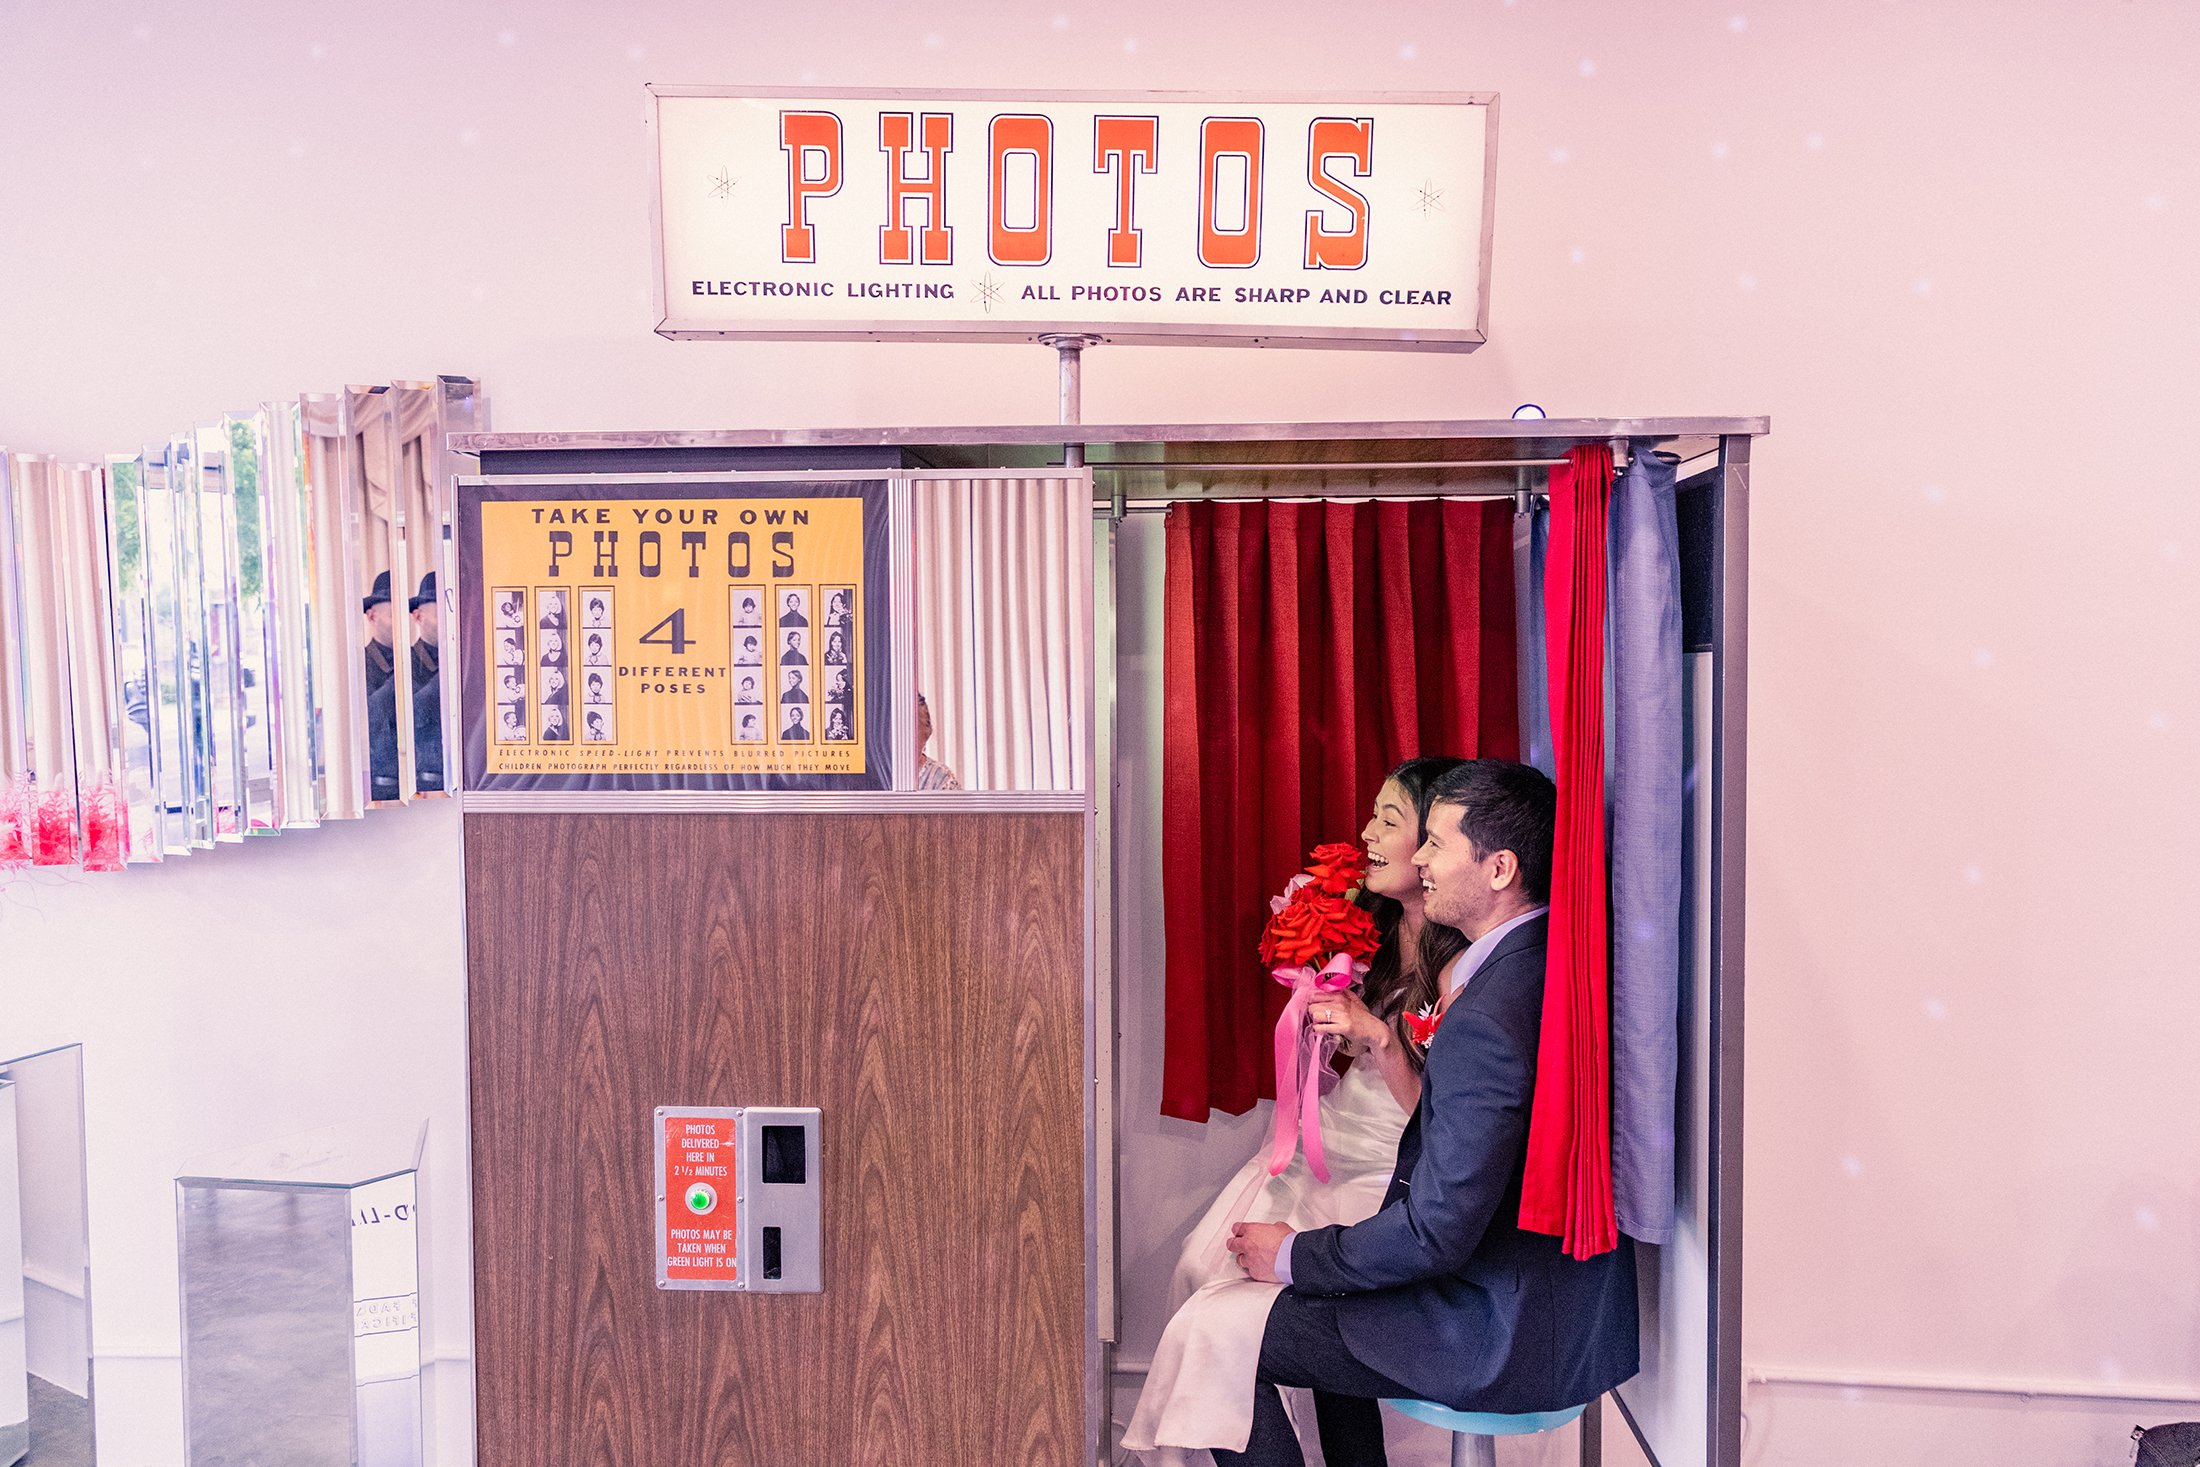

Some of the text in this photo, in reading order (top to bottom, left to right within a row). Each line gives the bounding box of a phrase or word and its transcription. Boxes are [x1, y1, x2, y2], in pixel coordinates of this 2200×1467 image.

[779, 110, 1374, 270] PHOTOS
[692, 280, 1452, 305] ELECTRONIC LIGHTING ALL PHOTOS ARE SHARP AND CLEAR
[531, 508, 809, 525] TAKE YOUR OWN
[549, 531, 794, 577] PHOTOS
[639, 608, 696, 654] 4
[618, 666, 726, 678] DIFFERENT
[641, 683, 706, 694] POSES
[499, 749, 850, 758] ELECTRONIC SPEED-LIGHT PREVENTS BLURRED PICTURES
[613, 763, 659, 771] PERFECTLY
[664, 763, 718, 771] REGARDLESS
[723, 763, 735, 771] OF
[685, 1124, 716, 1135] PHOTOS
[681, 1137, 720, 1149] DELIVERED
[686, 1151, 715, 1163] HERE IN
[694, 1165, 728, 1177] MINUTES
[670, 1228, 733, 1240] PHOTOS MAY BE
[677, 1242, 726, 1254] TAKEN WHEN
[666, 1256, 736, 1268] GREEN LIGHT IS ON
